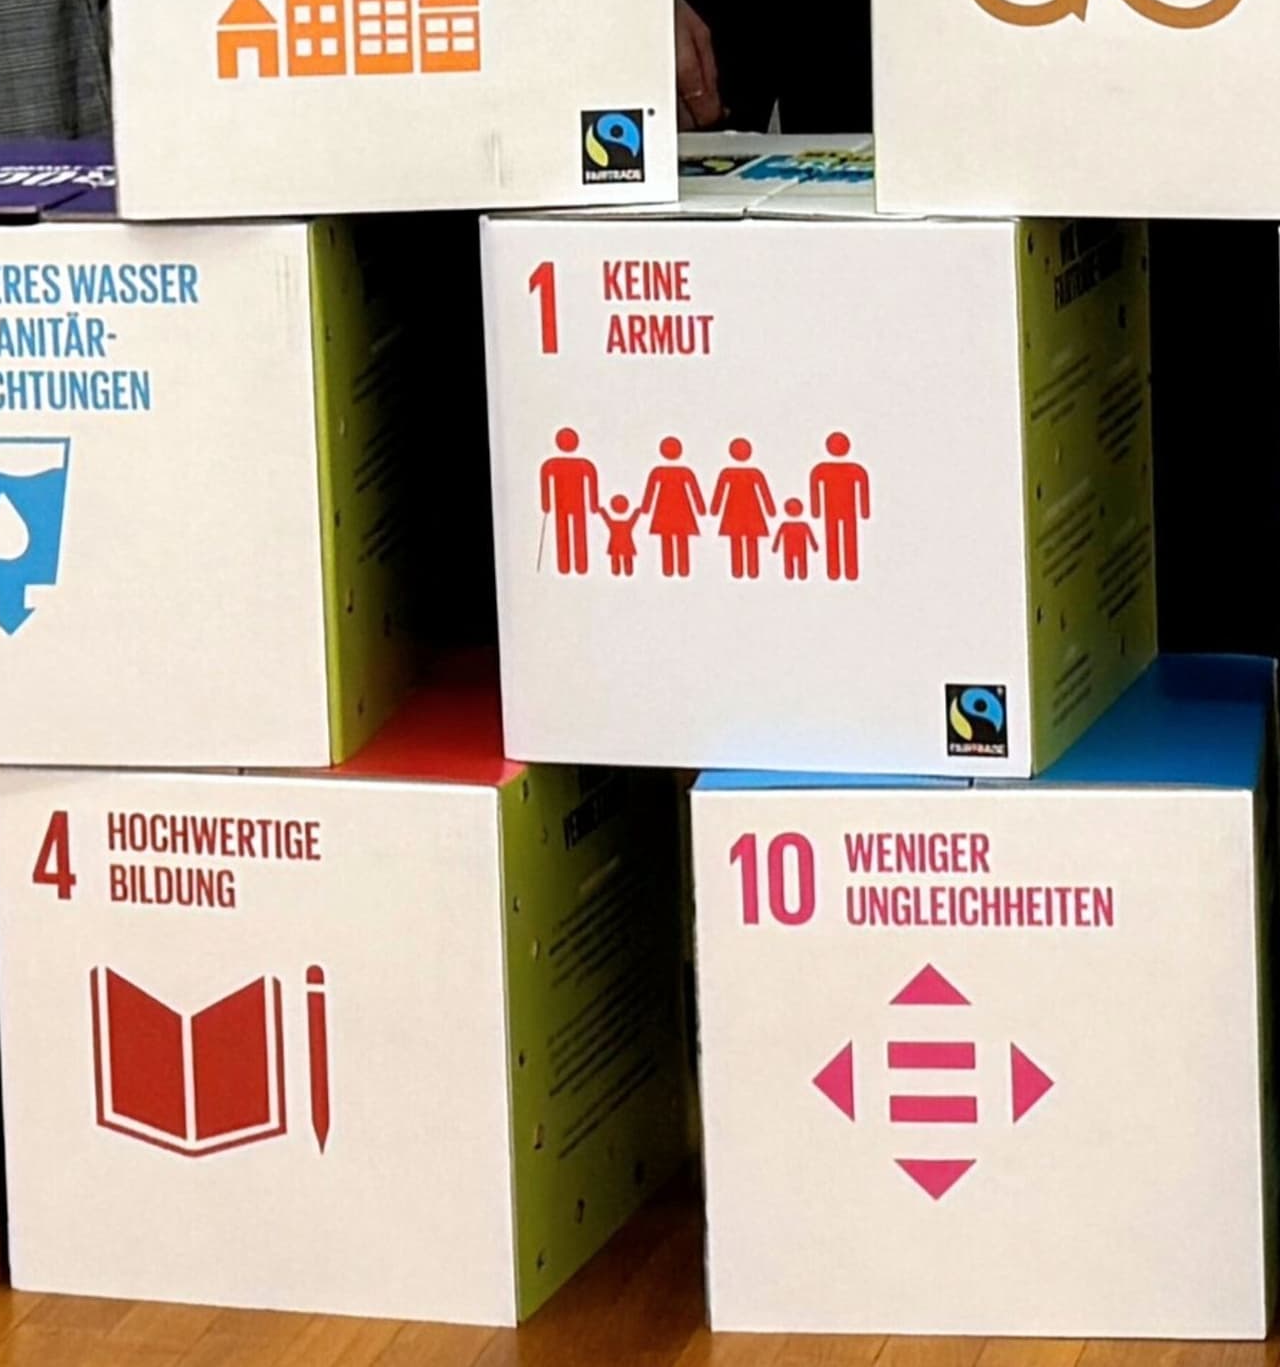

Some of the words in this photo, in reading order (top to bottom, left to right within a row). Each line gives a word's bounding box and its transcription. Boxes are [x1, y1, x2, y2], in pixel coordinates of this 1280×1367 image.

[68, 264, 198, 304] WASSER
[603, 261, 690, 301] KEINE
[529, 262, 558, 354] 1
[607, 314, 714, 354] ARMUT
[32, 810, 76, 900] 4
[108, 812, 321, 861] HOCHWERTIGE
[845, 833, 989, 873] WENIGER
[110, 865, 235, 908] BILDUNG
[730, 832, 815, 926] 10
[847, 886, 1113, 926] UNGLEICHHEITEN
